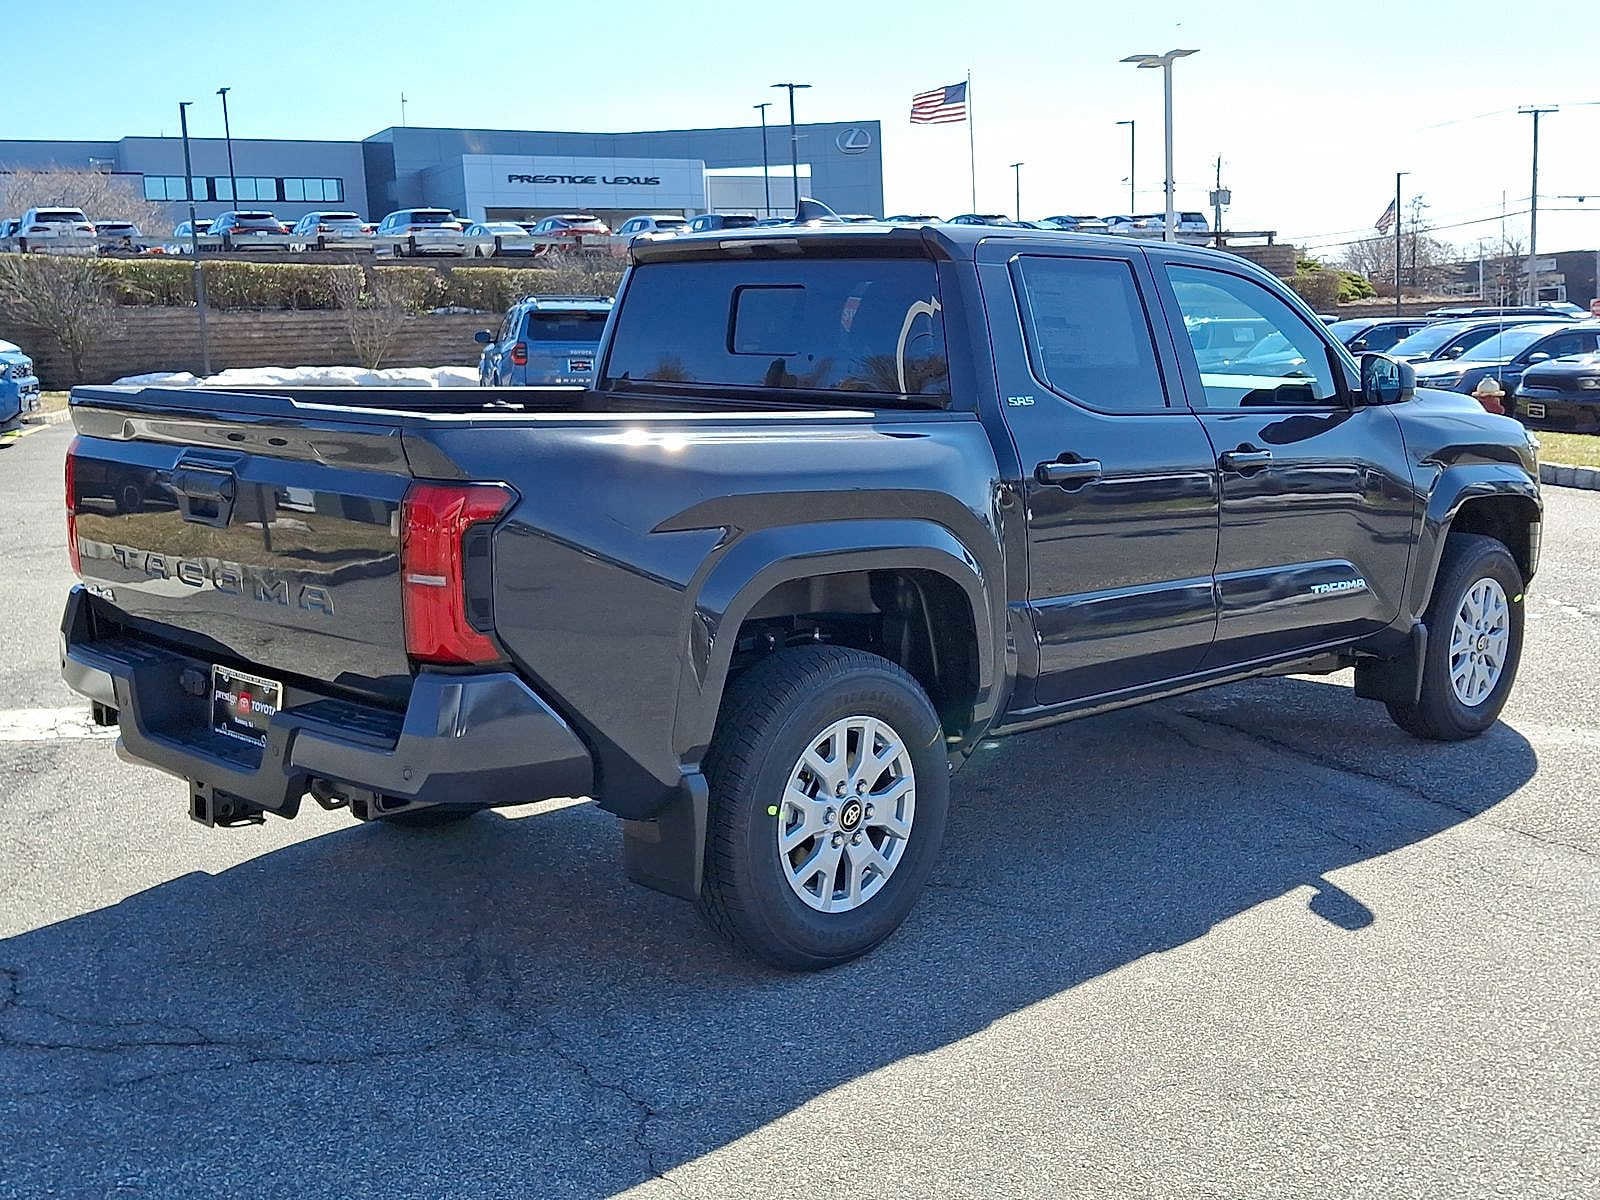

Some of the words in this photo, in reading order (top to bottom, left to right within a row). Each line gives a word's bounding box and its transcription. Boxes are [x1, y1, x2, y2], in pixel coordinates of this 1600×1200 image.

[508, 174, 598, 185] PRESTIGE
[602, 176, 661, 186] LEXUS
[1008, 396, 1035, 406] SR5
[112, 543, 335, 617] TACOMA
[1310, 578, 1366, 594] TACOMA
